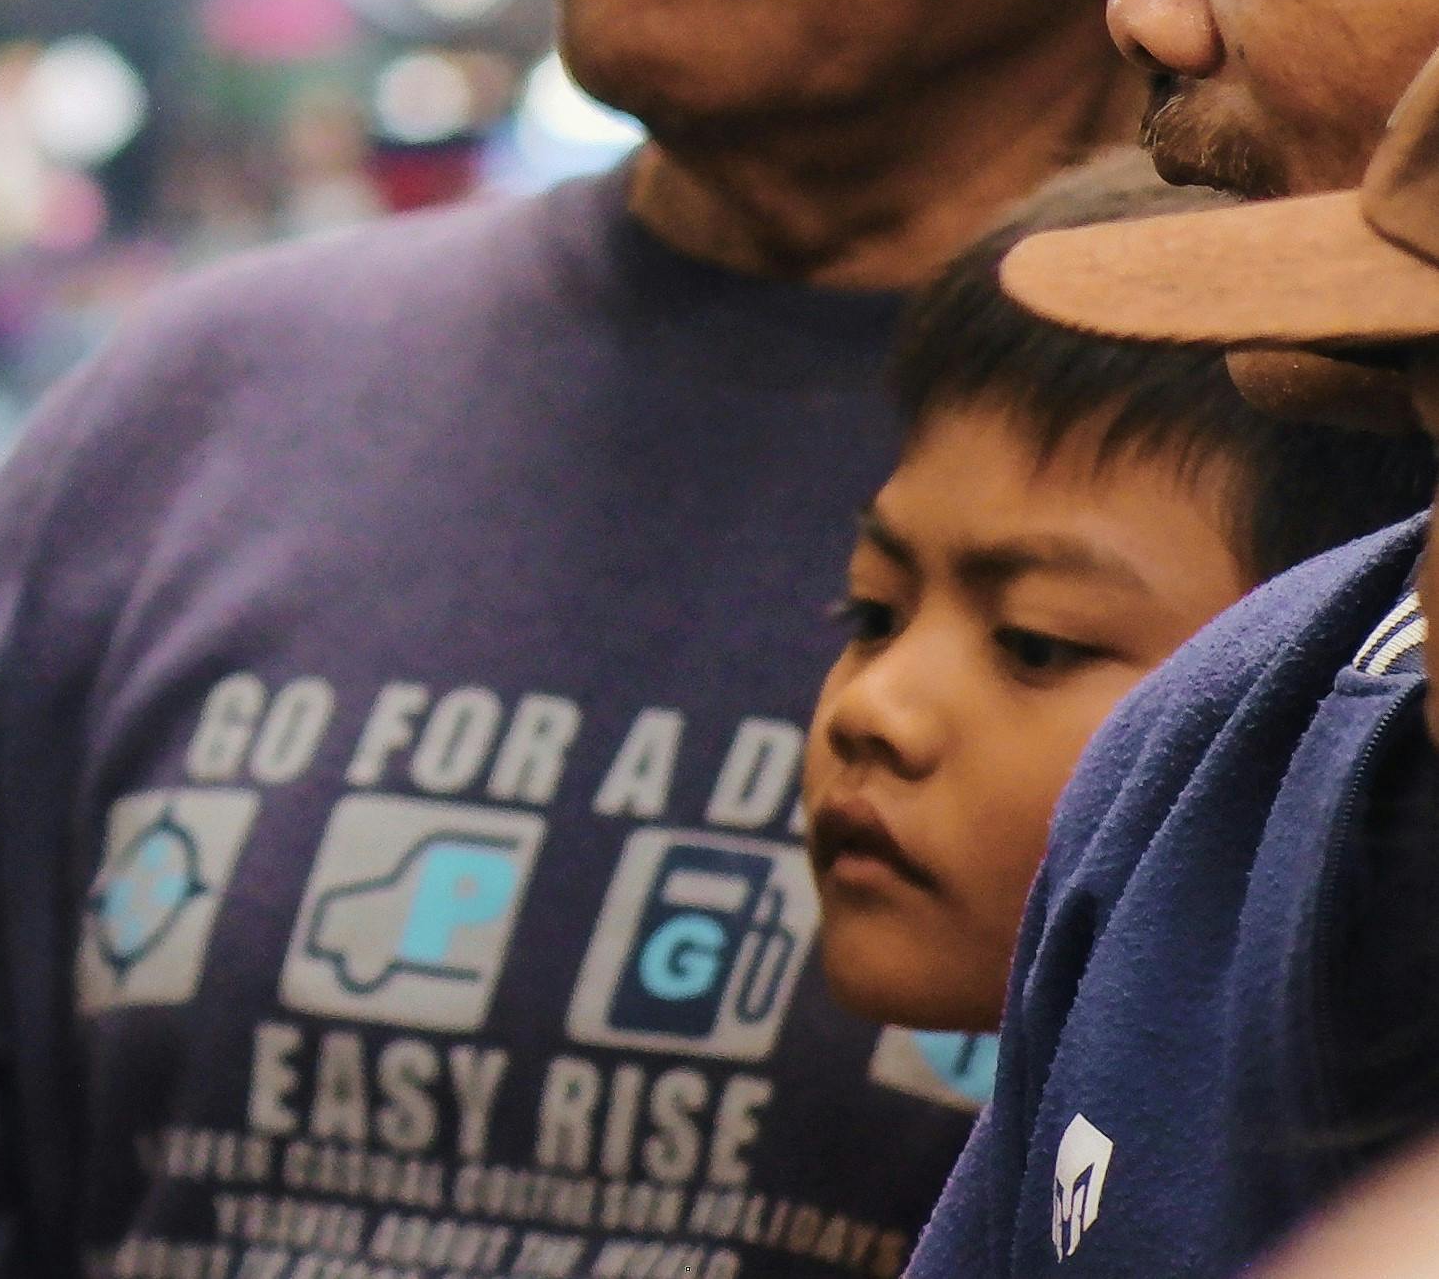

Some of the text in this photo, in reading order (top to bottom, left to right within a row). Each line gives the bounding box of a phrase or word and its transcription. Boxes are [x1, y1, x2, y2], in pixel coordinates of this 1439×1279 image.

[186, 671, 810, 831] GO FOR A D
[398, 842, 518, 963] P
[639, 913, 731, 1000] G
[246, 1020, 510, 1155] EASY
[536, 1046, 774, 1186] RISE
